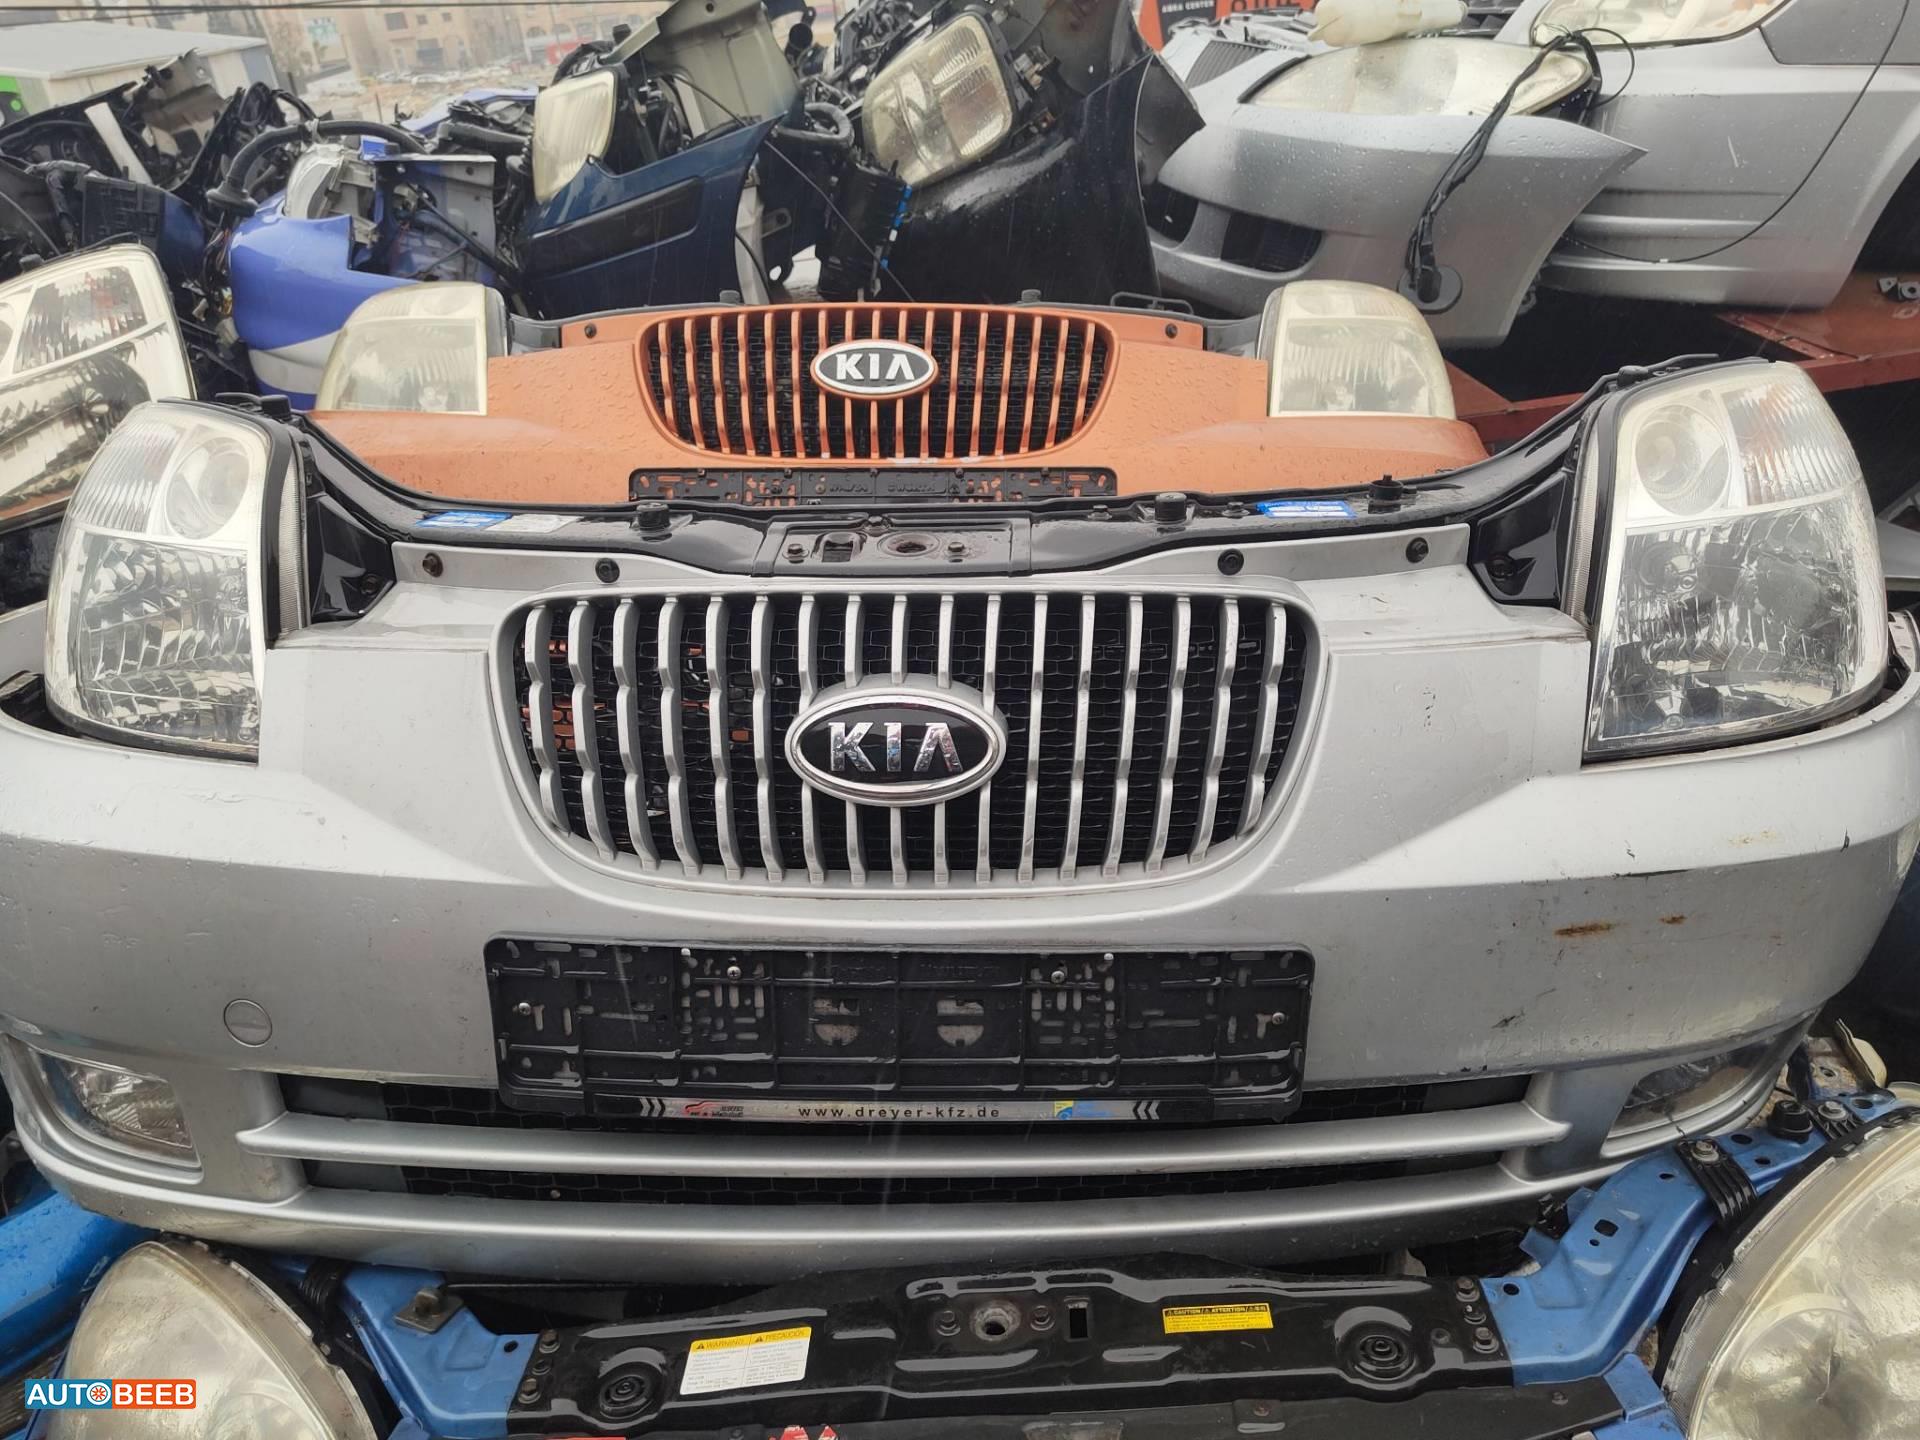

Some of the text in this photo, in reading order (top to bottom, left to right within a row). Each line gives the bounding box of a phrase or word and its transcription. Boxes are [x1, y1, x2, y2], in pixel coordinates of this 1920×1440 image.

[836, 353, 915, 380] KIA
[828, 722, 963, 772] KIA
[798, 1106, 999, 1120] www.dreyer-kfz.de
